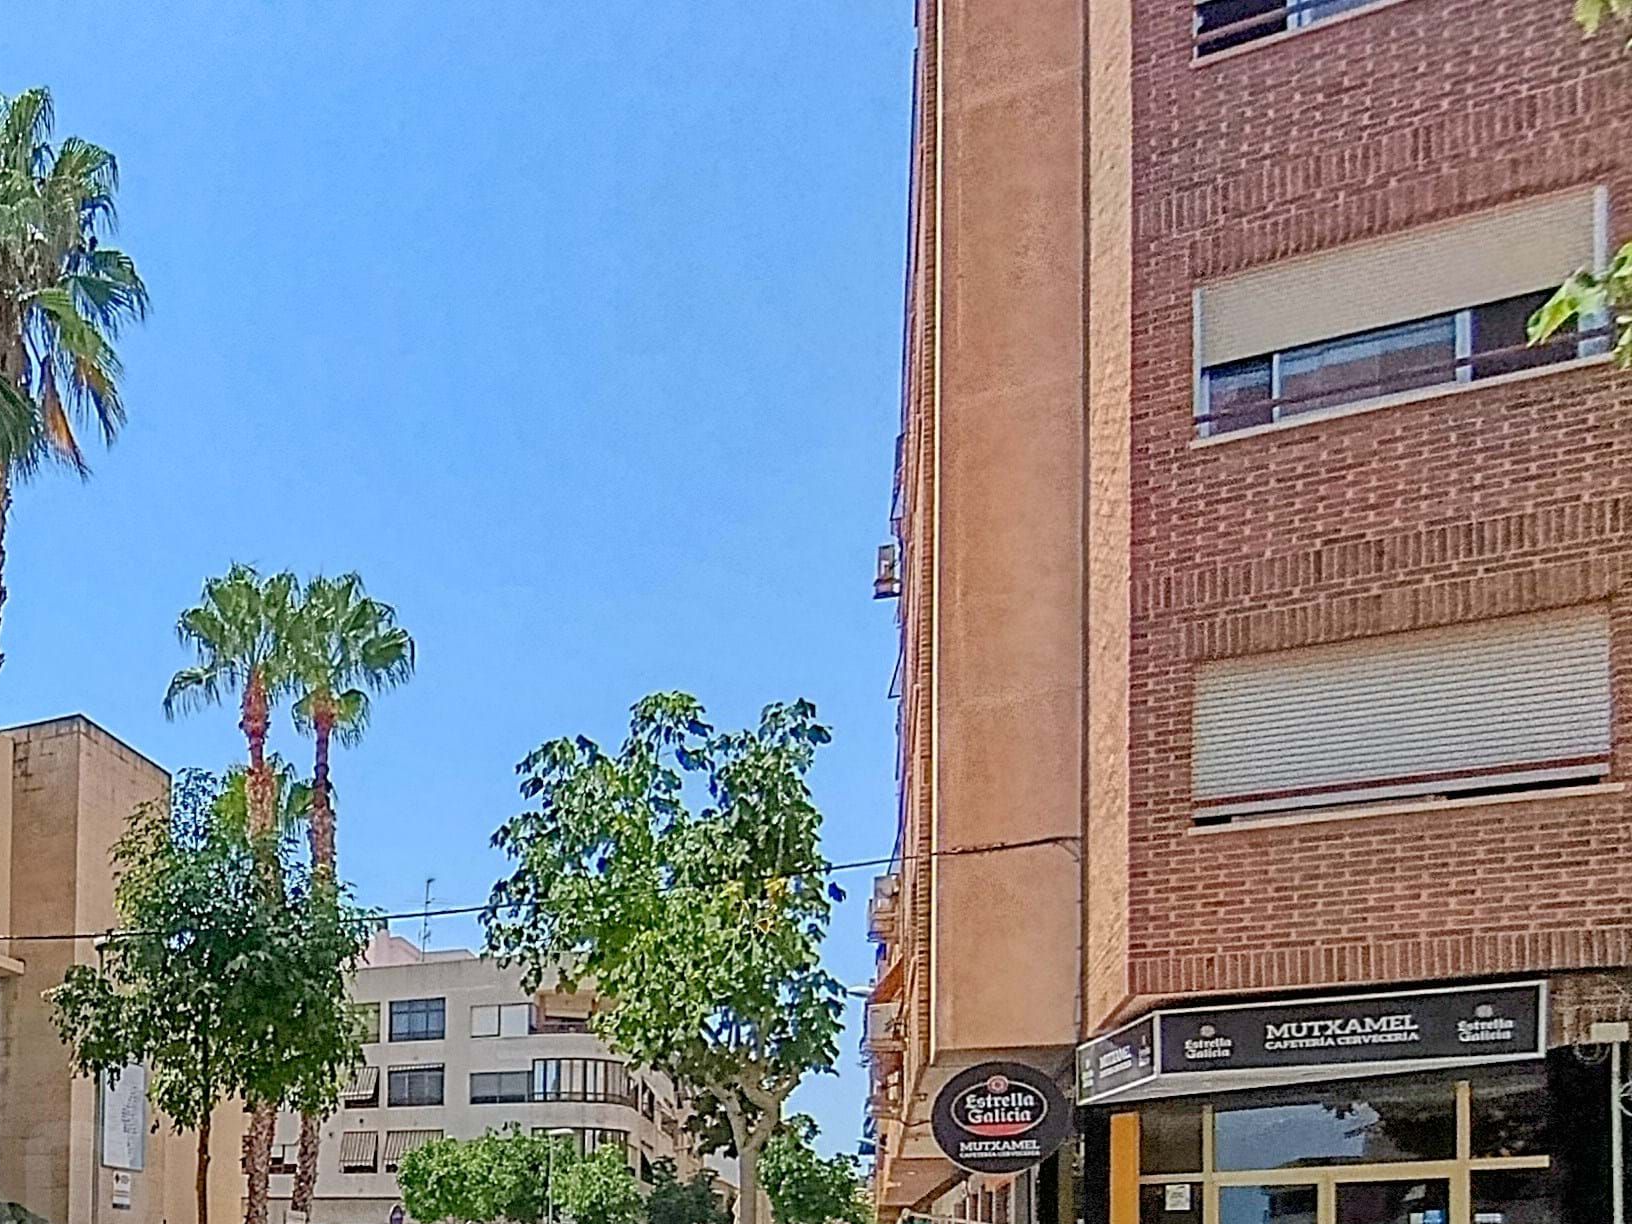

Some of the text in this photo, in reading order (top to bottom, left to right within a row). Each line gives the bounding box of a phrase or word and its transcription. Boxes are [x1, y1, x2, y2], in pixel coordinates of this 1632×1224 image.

[1266, 1015, 1419, 1039] MUTXAMEL
[1457, 1018, 1514, 1033] Estrella
[1265, 1036, 1335, 1050] CAFETERÍA
[1458, 1030, 1512, 1042] Galicia
[1184, 1037, 1232, 1050] Estrella
[1185, 1048, 1231, 1059] Galicia
[965, 1093, 1034, 1108] Estrella
[967, 1108, 1033, 1124] Galicia
[959, 1140, 1040, 1152] MUTXAMEL
